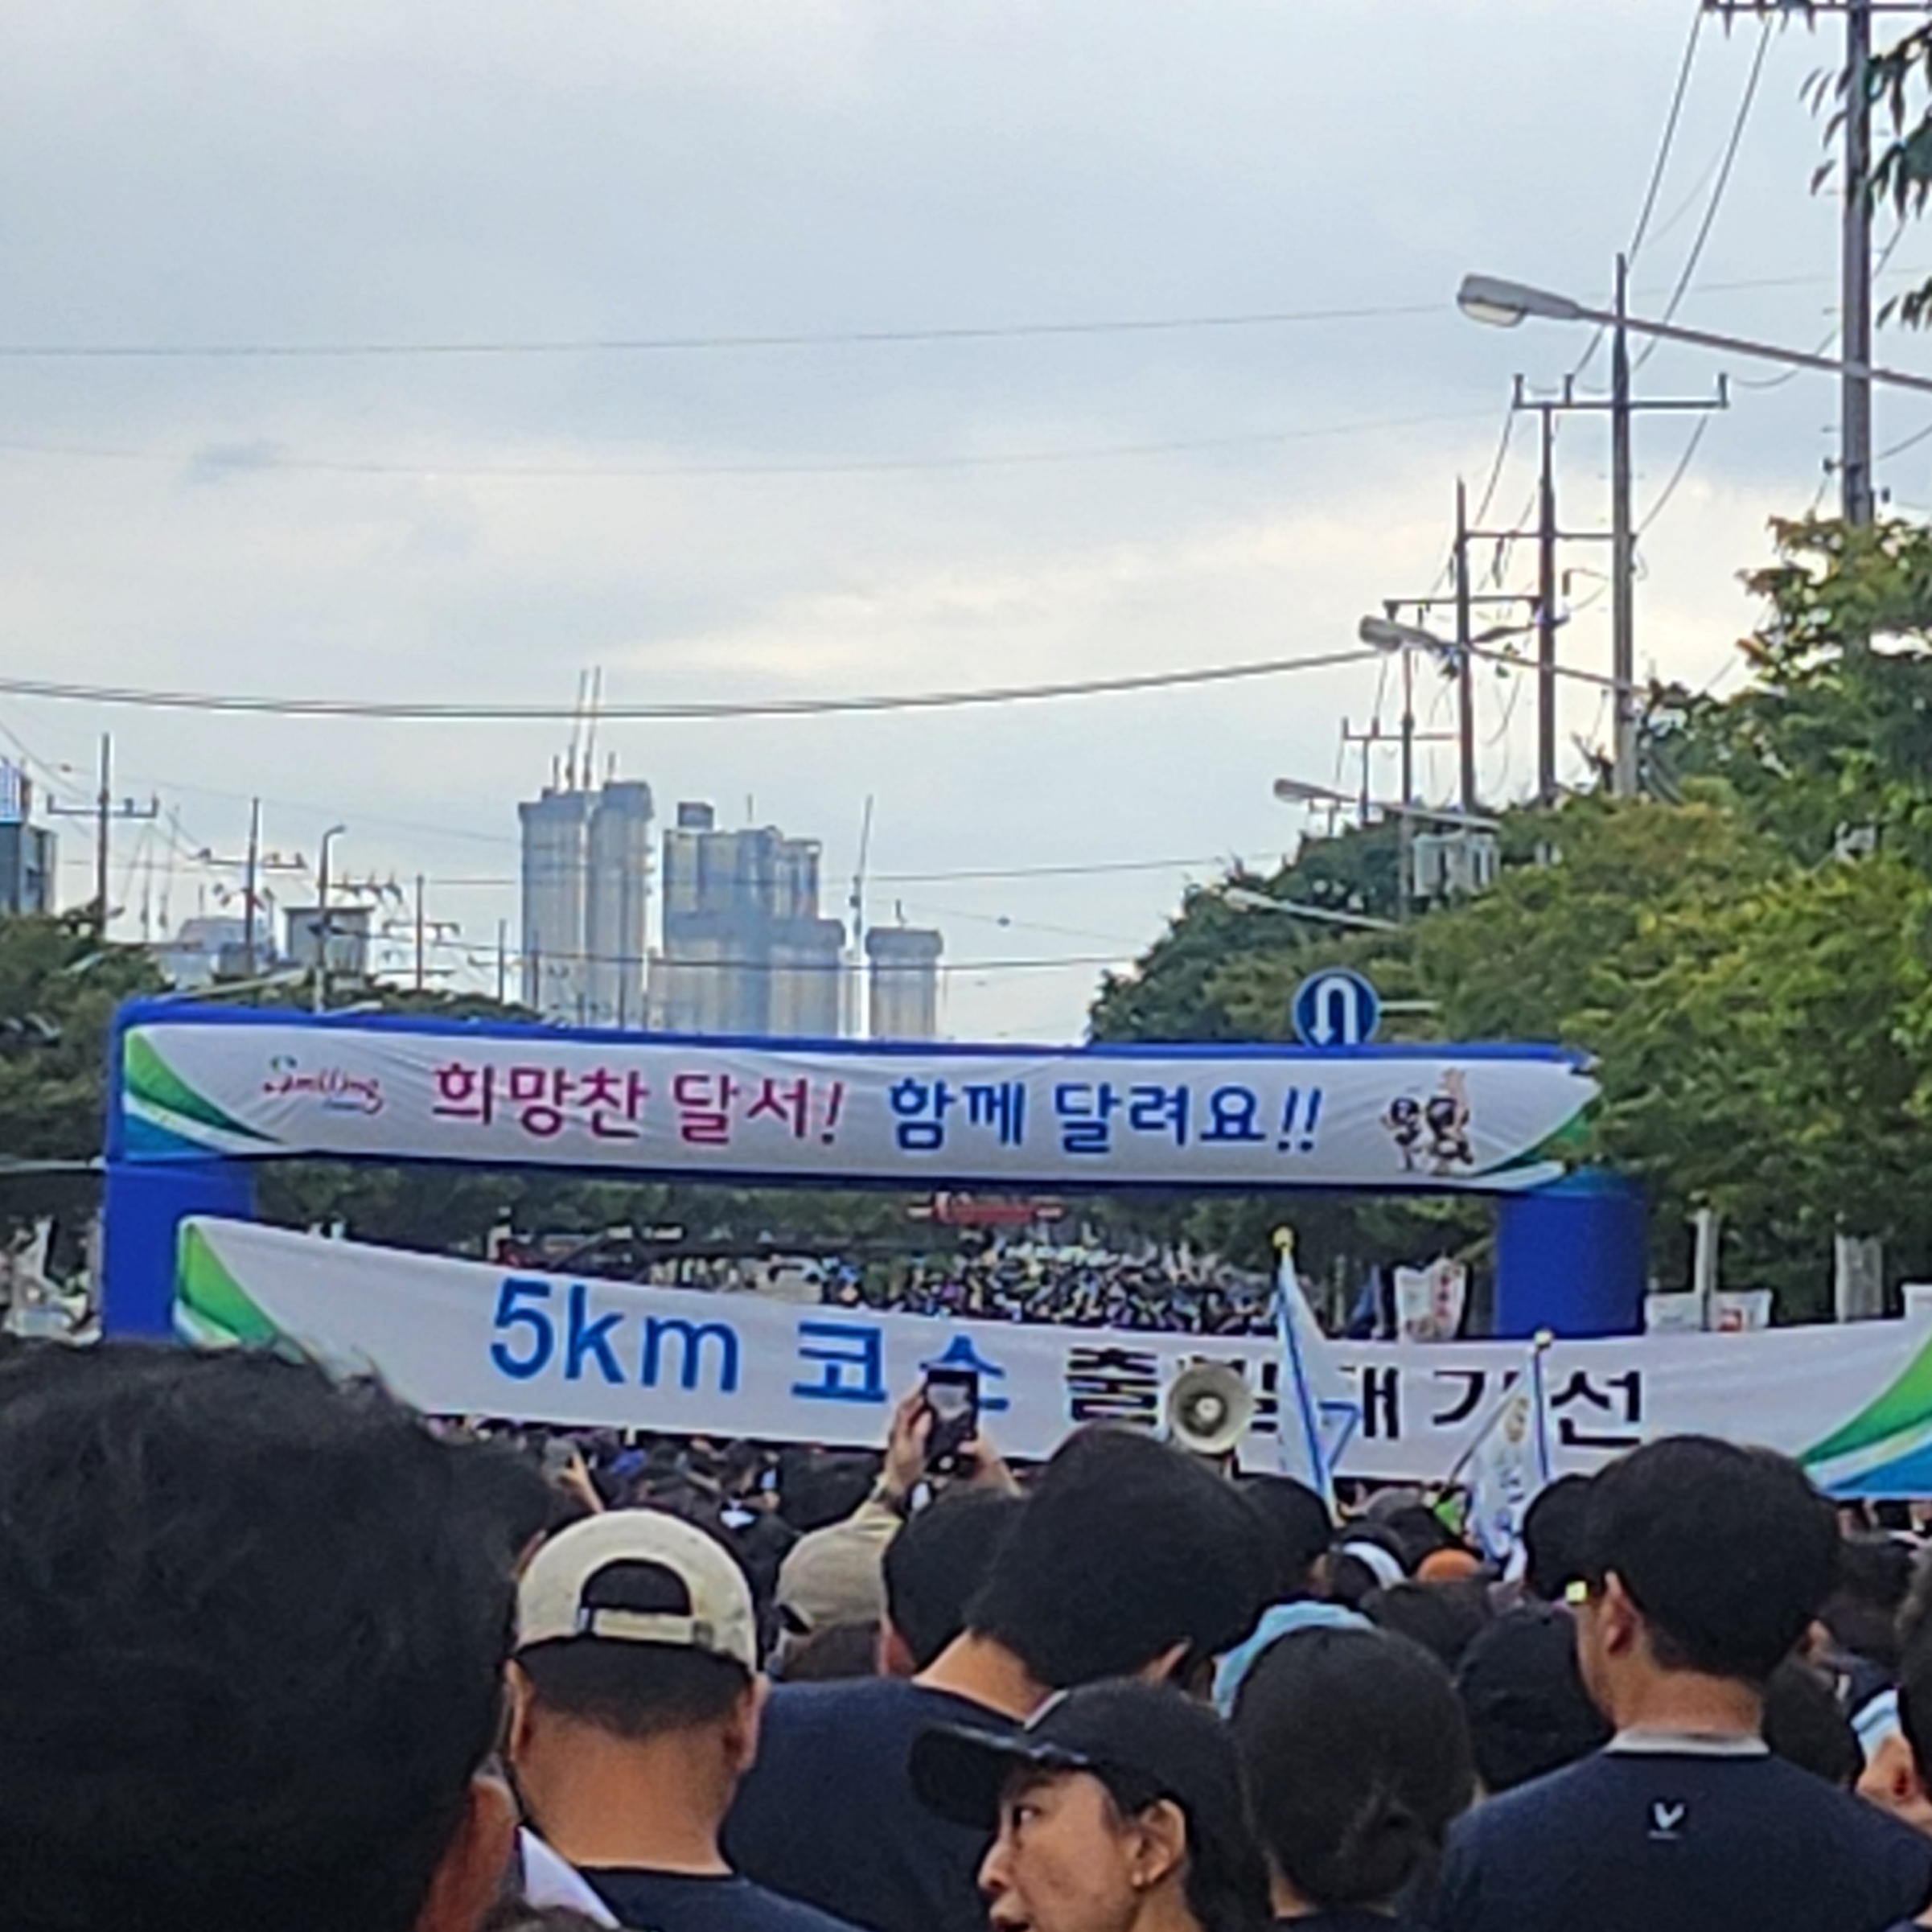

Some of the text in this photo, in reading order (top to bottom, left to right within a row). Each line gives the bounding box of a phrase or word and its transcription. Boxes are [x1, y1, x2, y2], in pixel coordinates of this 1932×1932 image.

[432, 1063, 1322, 1154] 희망찬 달서! 함께 달려요!!
[491, 1277, 738, 1392] 5km
